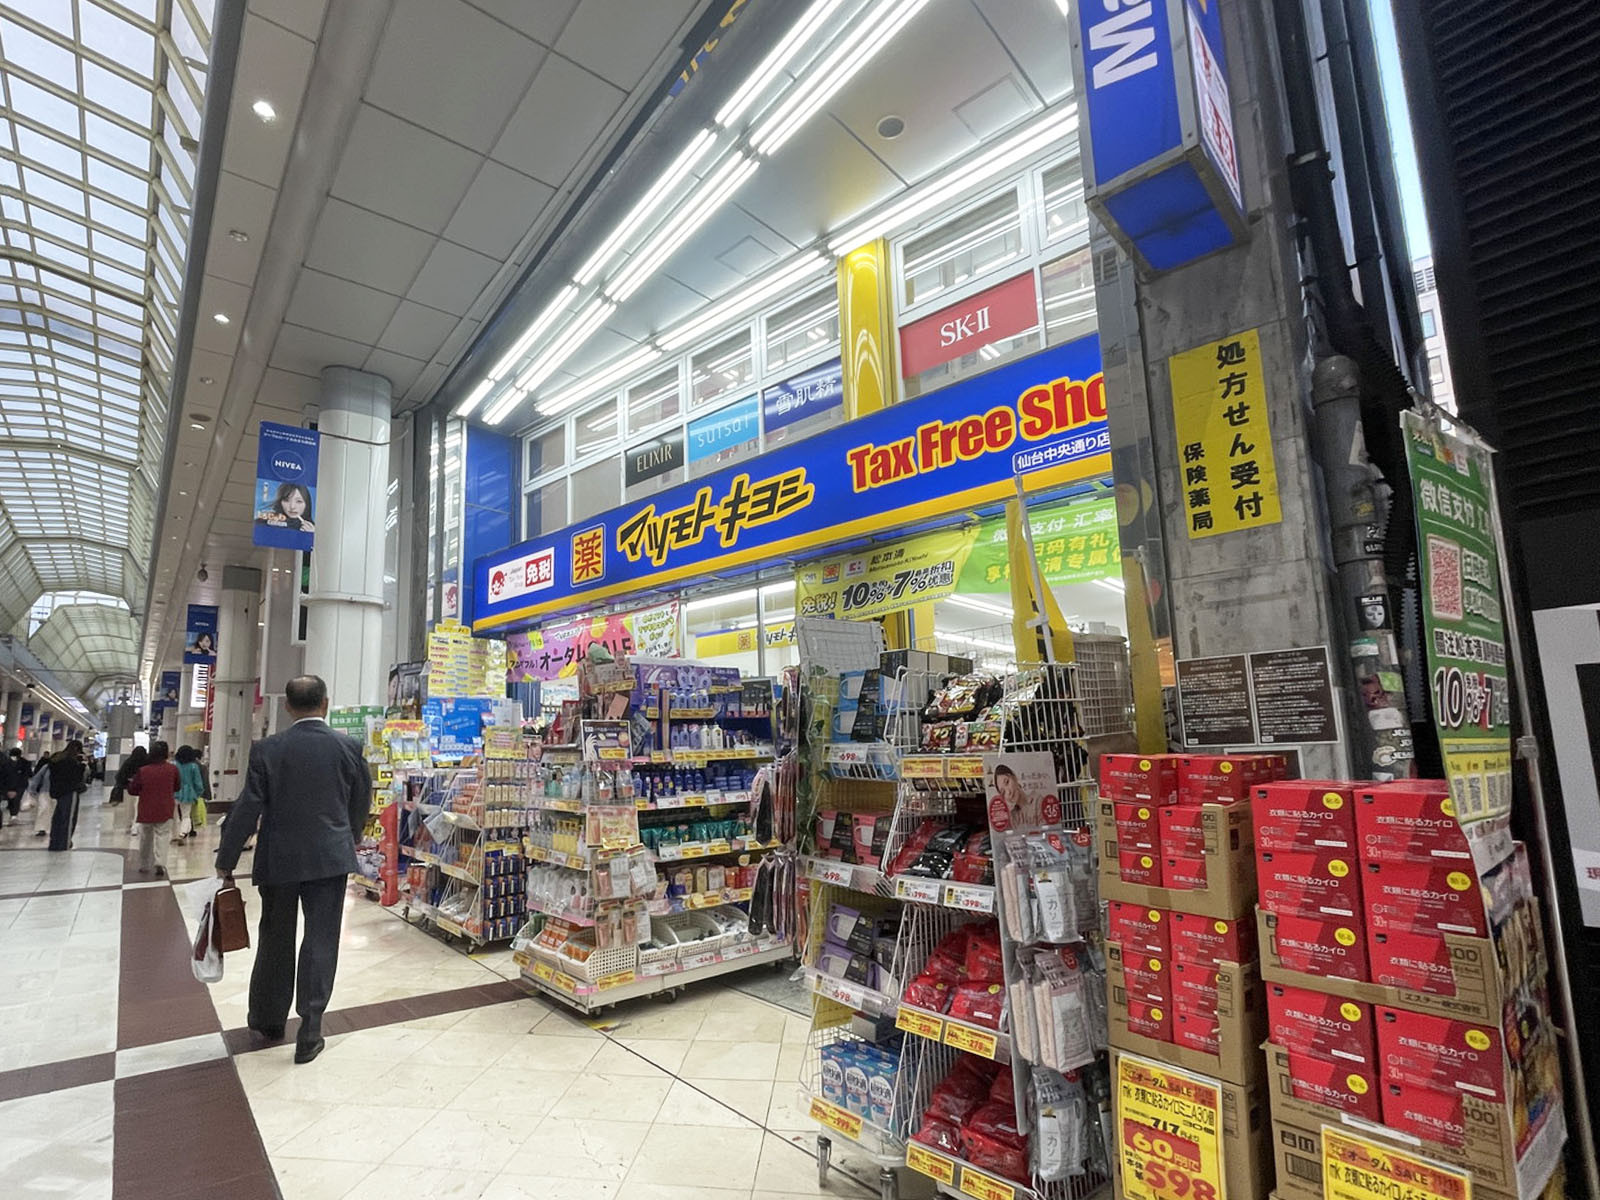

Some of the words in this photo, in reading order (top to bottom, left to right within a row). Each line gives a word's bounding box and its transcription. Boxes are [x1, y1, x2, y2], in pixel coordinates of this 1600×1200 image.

[776, 376, 837, 416] 雪肌精
[850, 439, 915, 489] Tax
[921, 409, 1013, 470] Free
[1017, 432, 1111, 470] 仙台中央通り店
[1216, 341, 1265, 521] 処方せん受付
[274, 459, 302, 471] NIVEA
[636, 444, 672, 473] ELIXIR
[1183, 441, 1214, 532] 保険薬局
[619, 471, 811, 562] マツモトキヨシ
[526, 558, 552, 585] 免税
[573, 531, 604, 578] 薬
[1132, 1131, 1174, 1161] 60
[1144, 1159, 1217, 1200] 598
